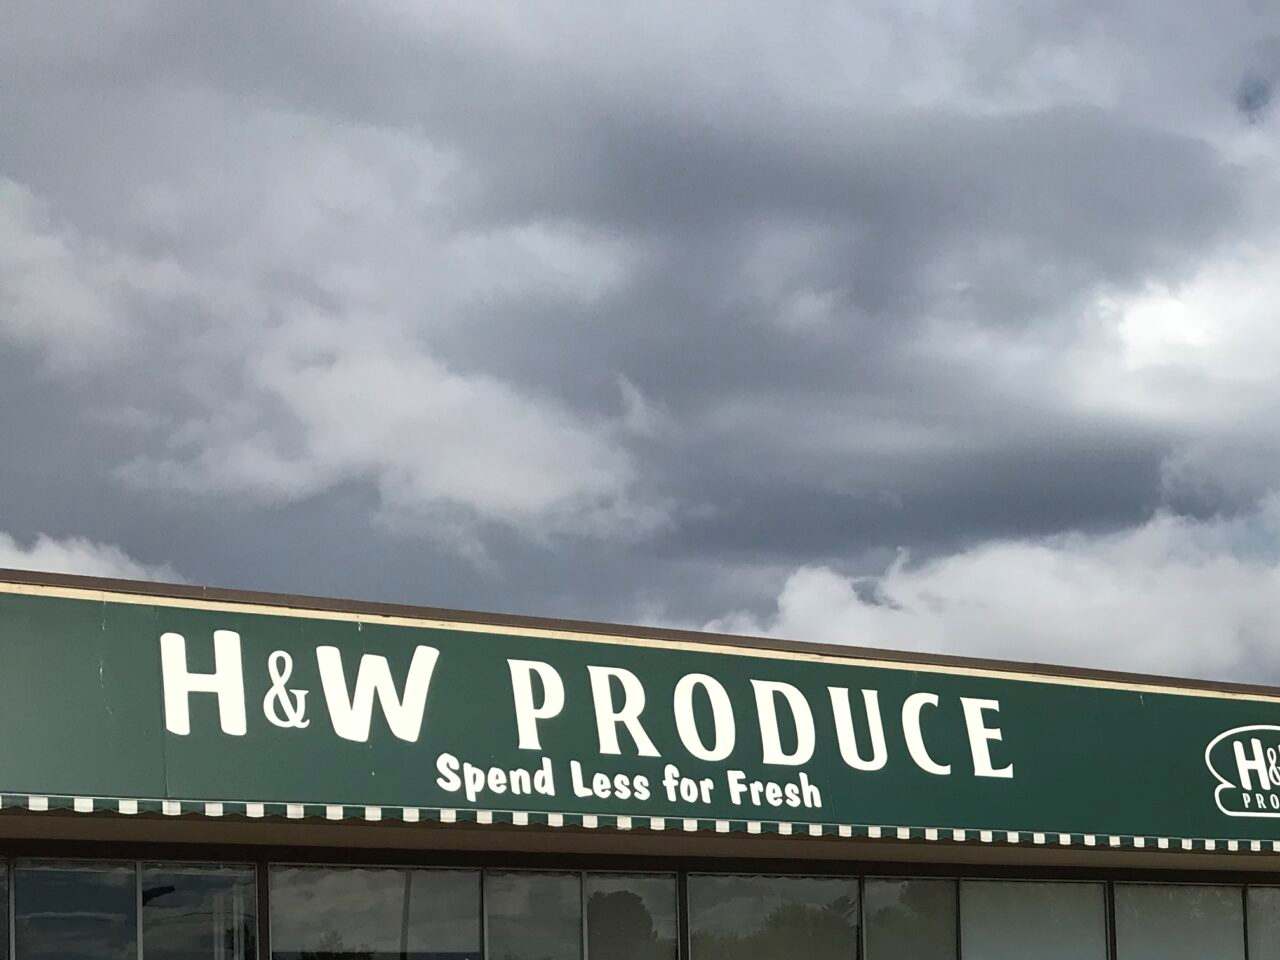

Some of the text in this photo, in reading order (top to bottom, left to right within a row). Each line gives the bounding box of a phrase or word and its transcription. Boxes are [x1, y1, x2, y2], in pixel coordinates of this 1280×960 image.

[506, 658, 1014, 779] PRODUCE
[436, 752, 822, 808] Spend Less for Fresh
